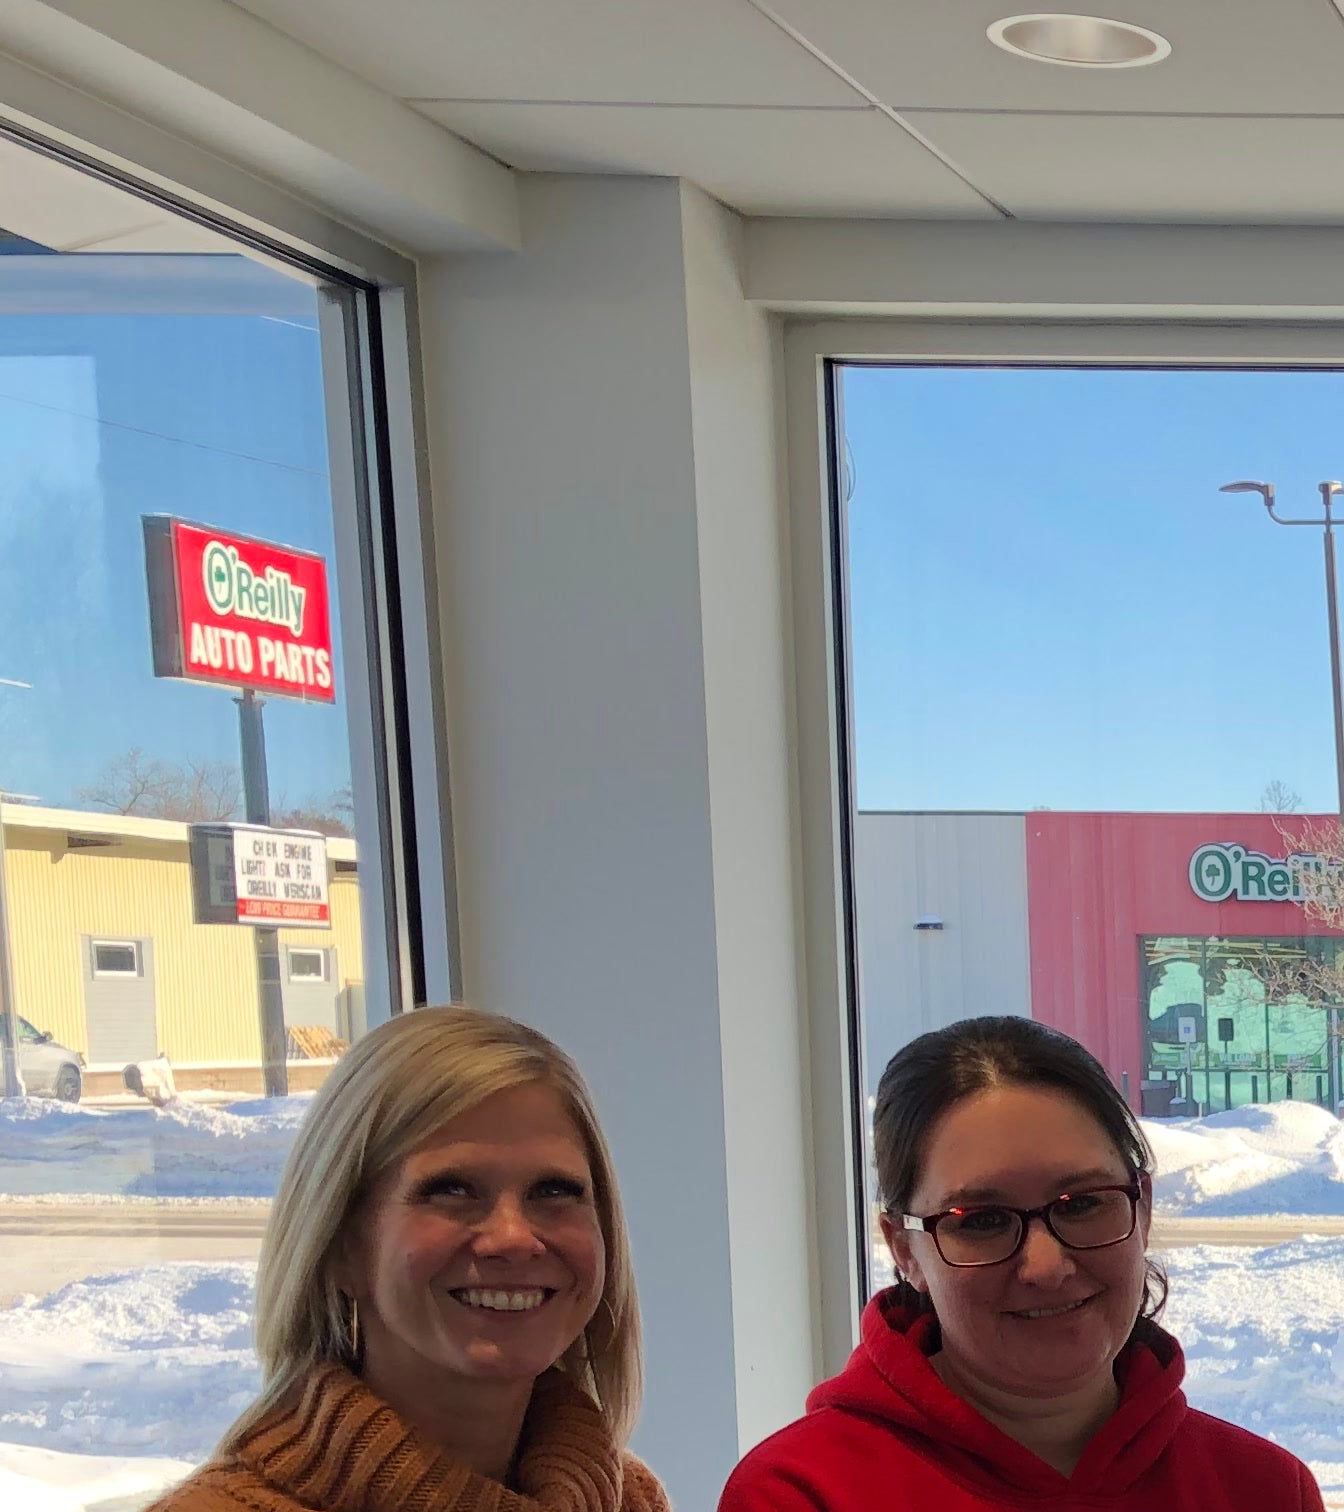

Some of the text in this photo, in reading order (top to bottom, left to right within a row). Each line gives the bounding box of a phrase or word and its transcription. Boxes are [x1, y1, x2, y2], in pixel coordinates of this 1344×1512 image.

[204, 543, 304, 635] O'Reilly
[190, 622, 331, 688] AUTO PARTS
[275, 862, 291, 879] ASK
[297, 863, 312, 880] FOR
